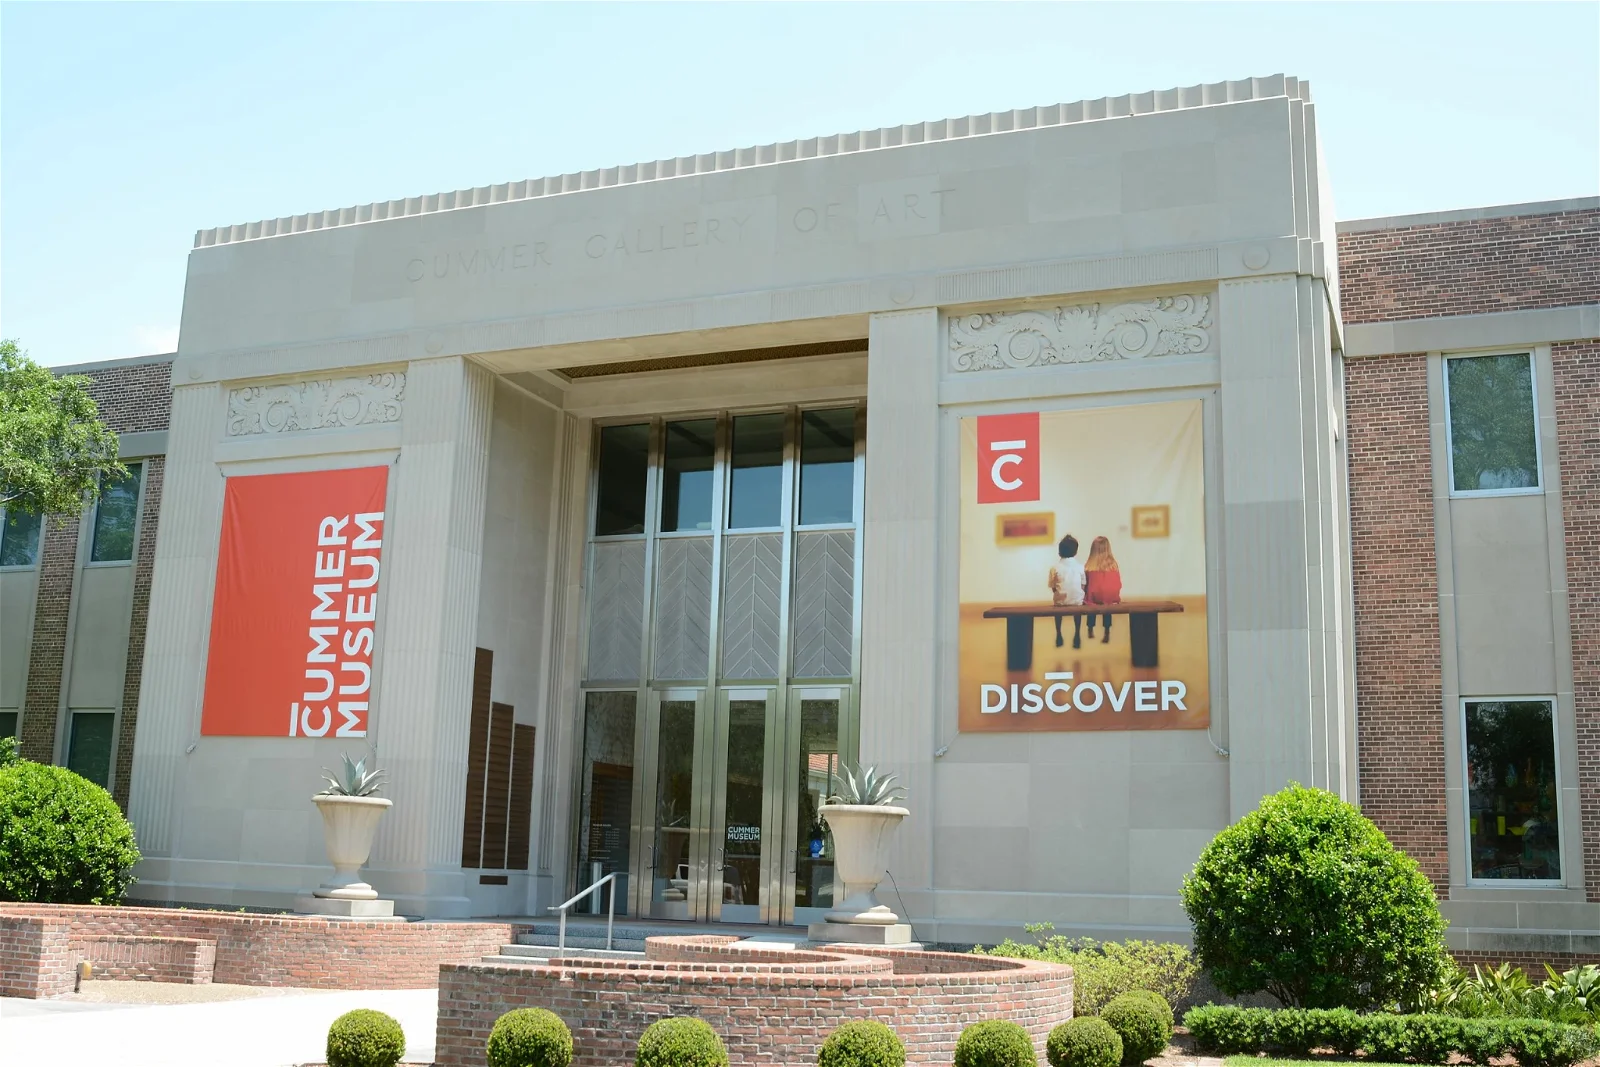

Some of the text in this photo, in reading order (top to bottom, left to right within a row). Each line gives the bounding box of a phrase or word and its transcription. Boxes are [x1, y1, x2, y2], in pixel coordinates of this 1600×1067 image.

[406, 187, 957, 283] CUMMER GALLERY OF ART
[289, 514, 350, 738] CUMMER
[335, 511, 385, 738] MUSEUM
[980, 671, 1187, 714] DISCOVER
[727, 826, 761, 834] CUMMER
